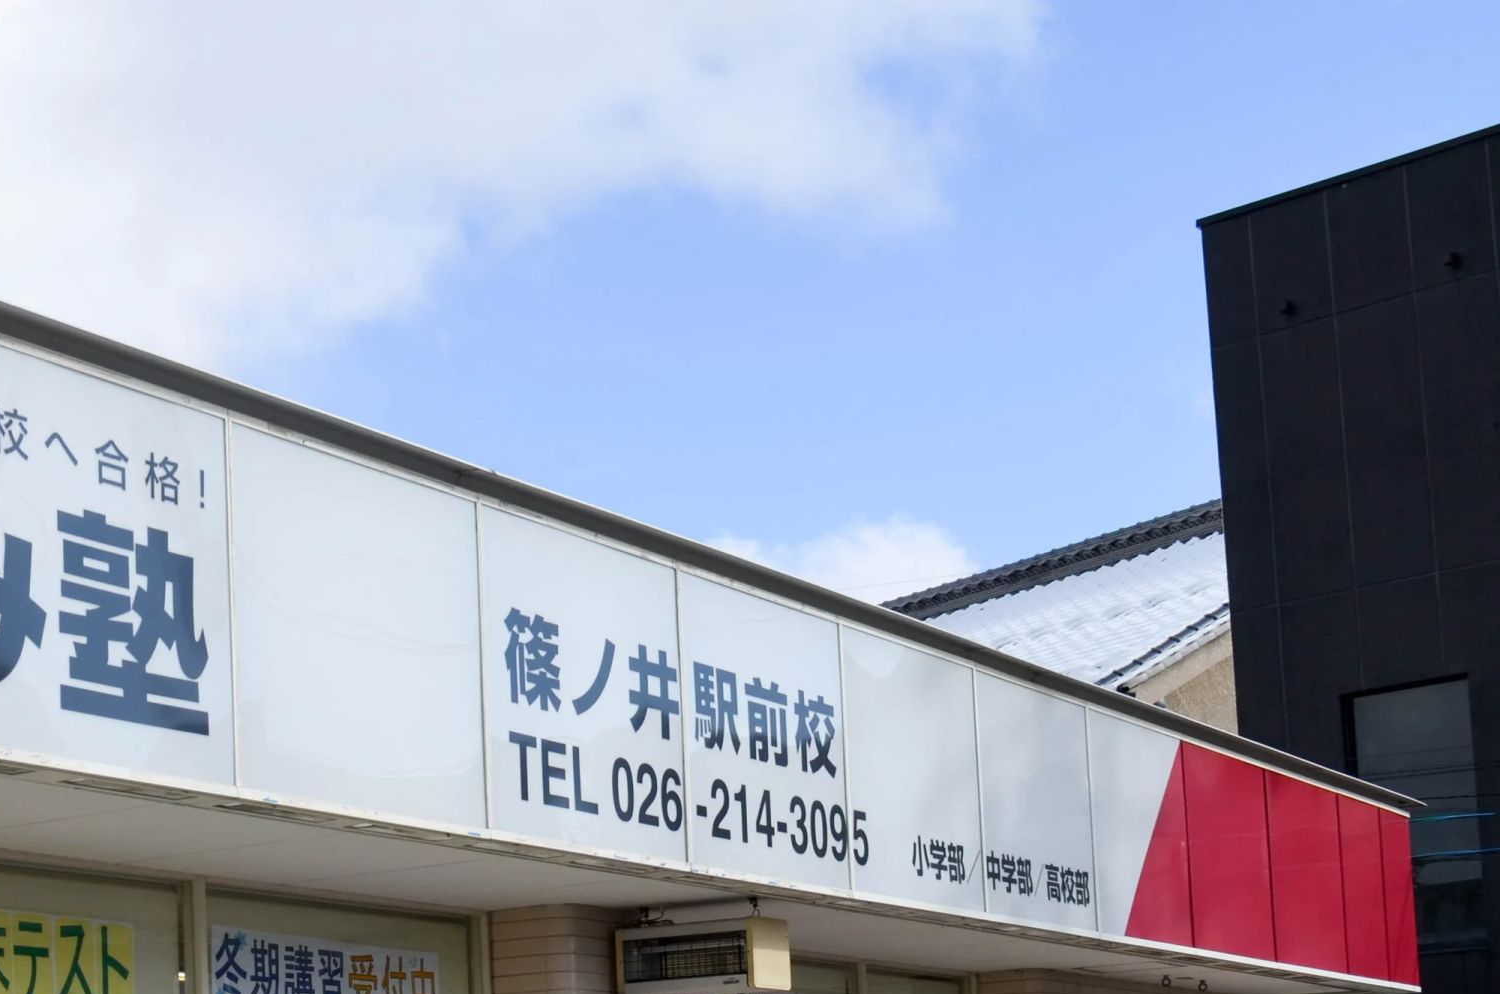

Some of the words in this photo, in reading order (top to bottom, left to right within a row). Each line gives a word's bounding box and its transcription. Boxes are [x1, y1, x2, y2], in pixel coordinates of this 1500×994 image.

[504, 607, 837, 778] 篠ノ井駅前校
[509, 731, 598, 816] TEL
